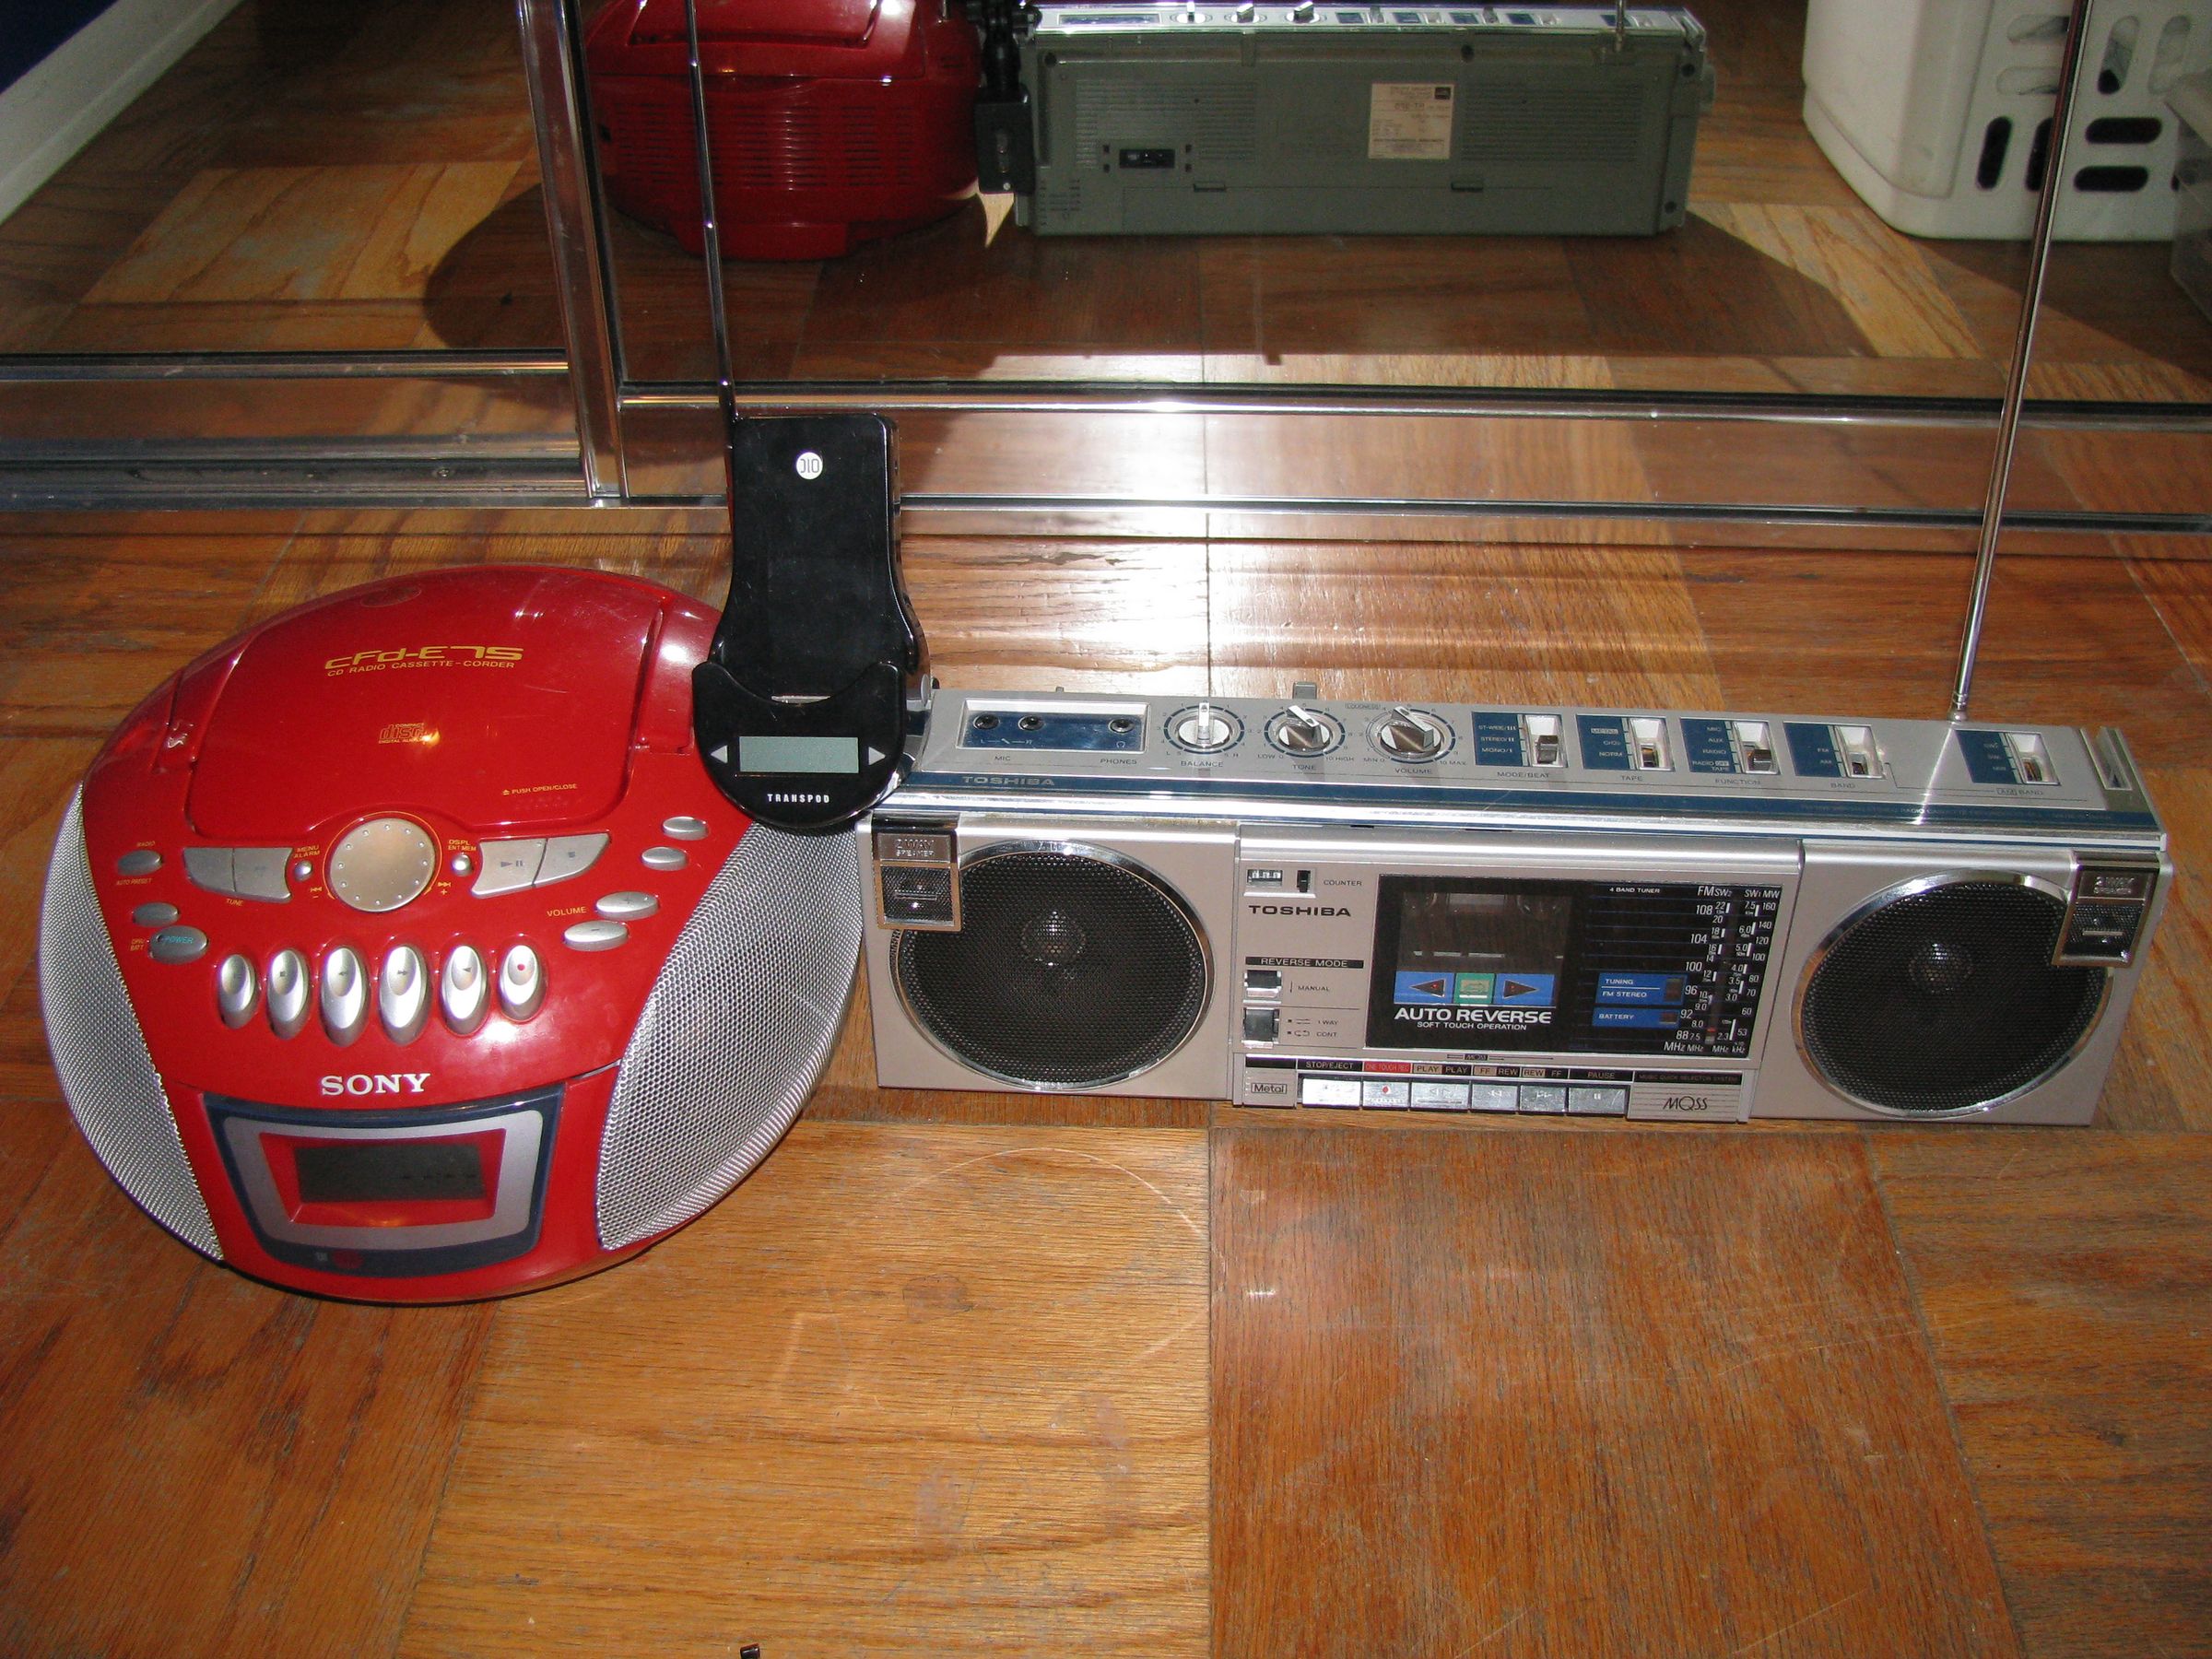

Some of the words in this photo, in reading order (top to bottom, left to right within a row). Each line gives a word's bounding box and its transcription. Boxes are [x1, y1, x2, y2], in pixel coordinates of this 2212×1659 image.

[327, 668, 344, 677] CD
[349, 664, 385, 674] RADIO
[962, 776, 1055, 786] TOSHIBA
[767, 794, 830, 804] TRANSPOD
[1698, 886, 1714, 897] FM
[1762, 889, 1781, 899] MW
[547, 906, 587, 917] VOLUME
[1248, 905, 1351, 917] TOSHIBA
[1696, 904, 1713, 915] 108
[1715, 901, 1726, 910] 22
[1745, 901, 1756, 910] 7.5
[1762, 902, 1776, 911] 160
[1712, 915, 1724, 924] 20
[1759, 921, 1772, 929] 140
[1712, 926, 1721, 935] 18
[1738, 925, 1751, 934] 6.0
[1690, 933, 1708, 944] 104
[1755, 936, 1769, 945] 120
[1735, 943, 1747, 951] 5.0
[1752, 953, 1766, 961] 100
[1261, 958, 1312, 967] REVERSE
[1314, 959, 1348, 968] MODE
[1685, 961, 1703, 971] 100
[1703, 970, 1712, 978] 12
[1731, 964, 1744, 972] 4.0
[1728, 976, 1740, 984] 3.5
[1684, 985, 1698, 995] 96
[1725, 994, 1737, 1002] 3.0
[1695, 1003, 1707, 1011] 9.0
[1394, 1007, 1453, 1021] AUTO
[1455, 1008, 1552, 1024] REVERSE
[1680, 1009, 1693, 1019] 92
[1676, 1030, 1688, 1040] 88
[1717, 1032, 1729, 1041] 2.3
[1664, 1041, 1685, 1052] MHz
[1732, 1045, 1746, 1053] kHz
[1305, 1061, 1354, 1070] STOP/EJECT
[1498, 1067, 1519, 1076] REW
[1524, 1067, 1545, 1077] REW
[1551, 1069, 1561, 1077] FF
[1587, 1071, 1616, 1079] PAUSE
[321, 1073, 431, 1096] SONY
[1254, 1083, 1285, 1093] Metal
[1663, 1096, 1708, 1111] MQSS
